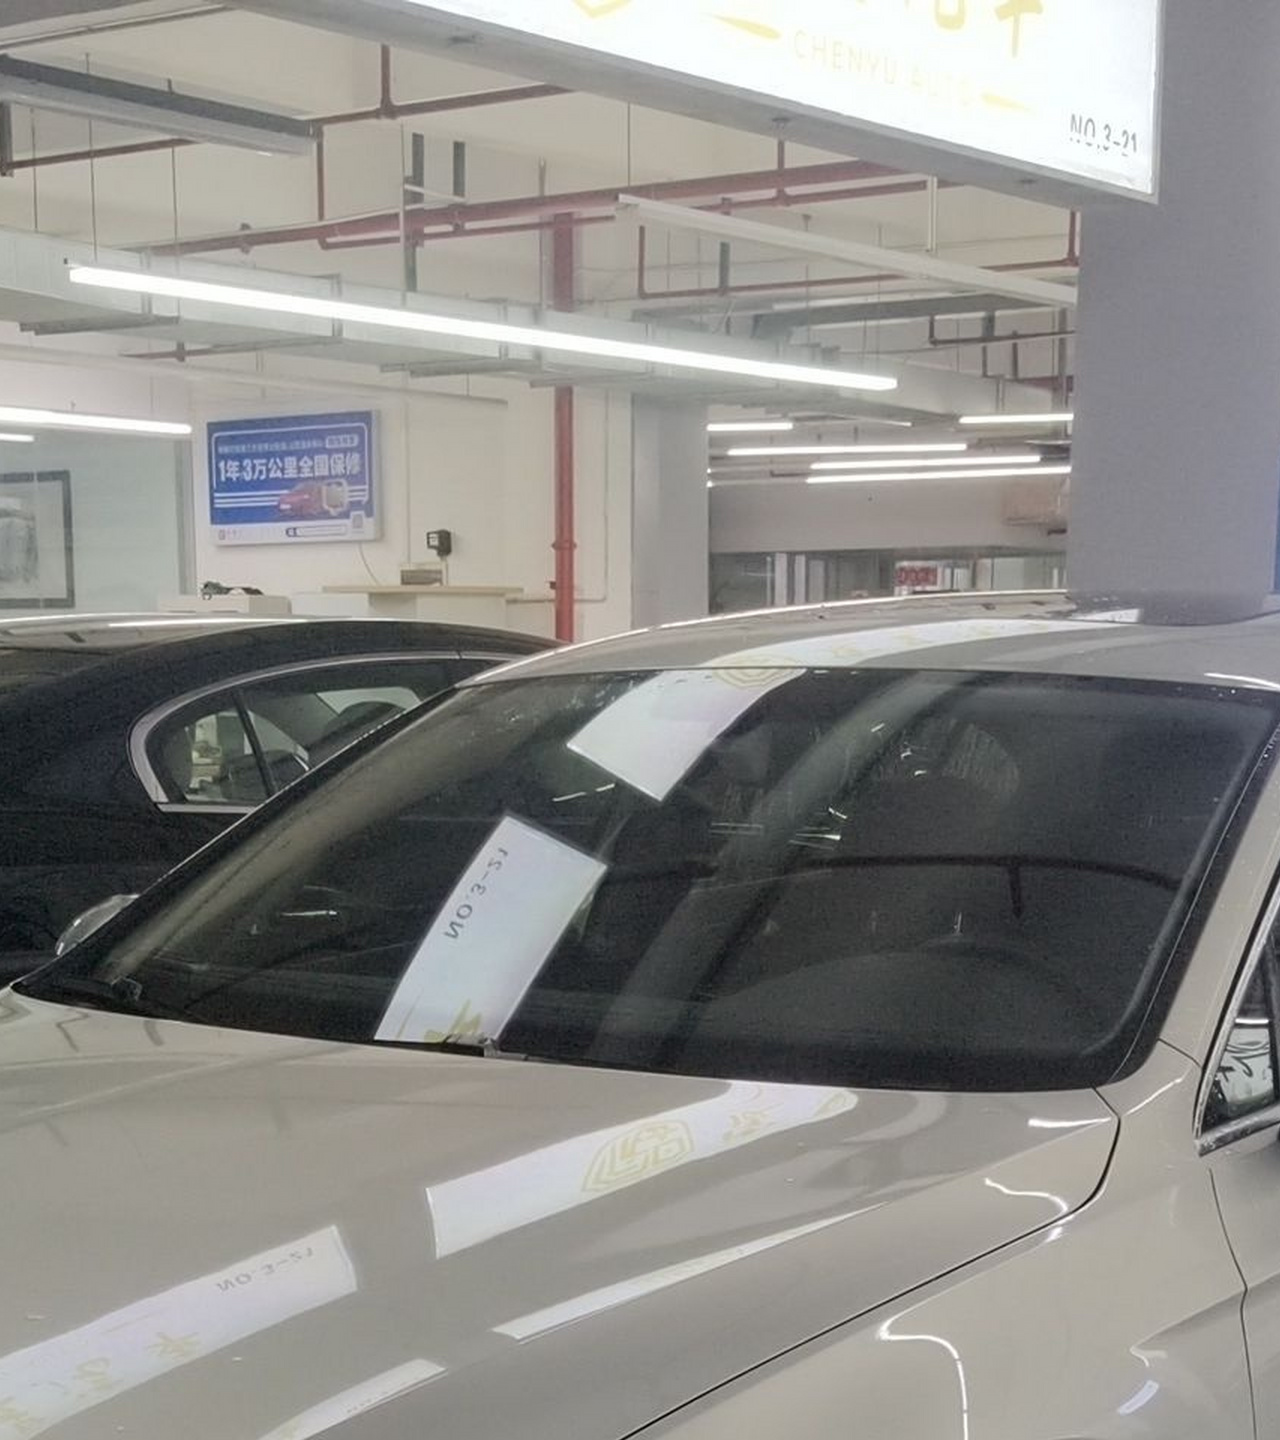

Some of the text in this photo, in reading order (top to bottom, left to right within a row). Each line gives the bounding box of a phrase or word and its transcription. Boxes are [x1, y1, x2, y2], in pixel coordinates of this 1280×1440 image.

[1069, 112, 1139, 157] NO.3-21
[217, 452, 362, 482] 1年3万公里全国保修
